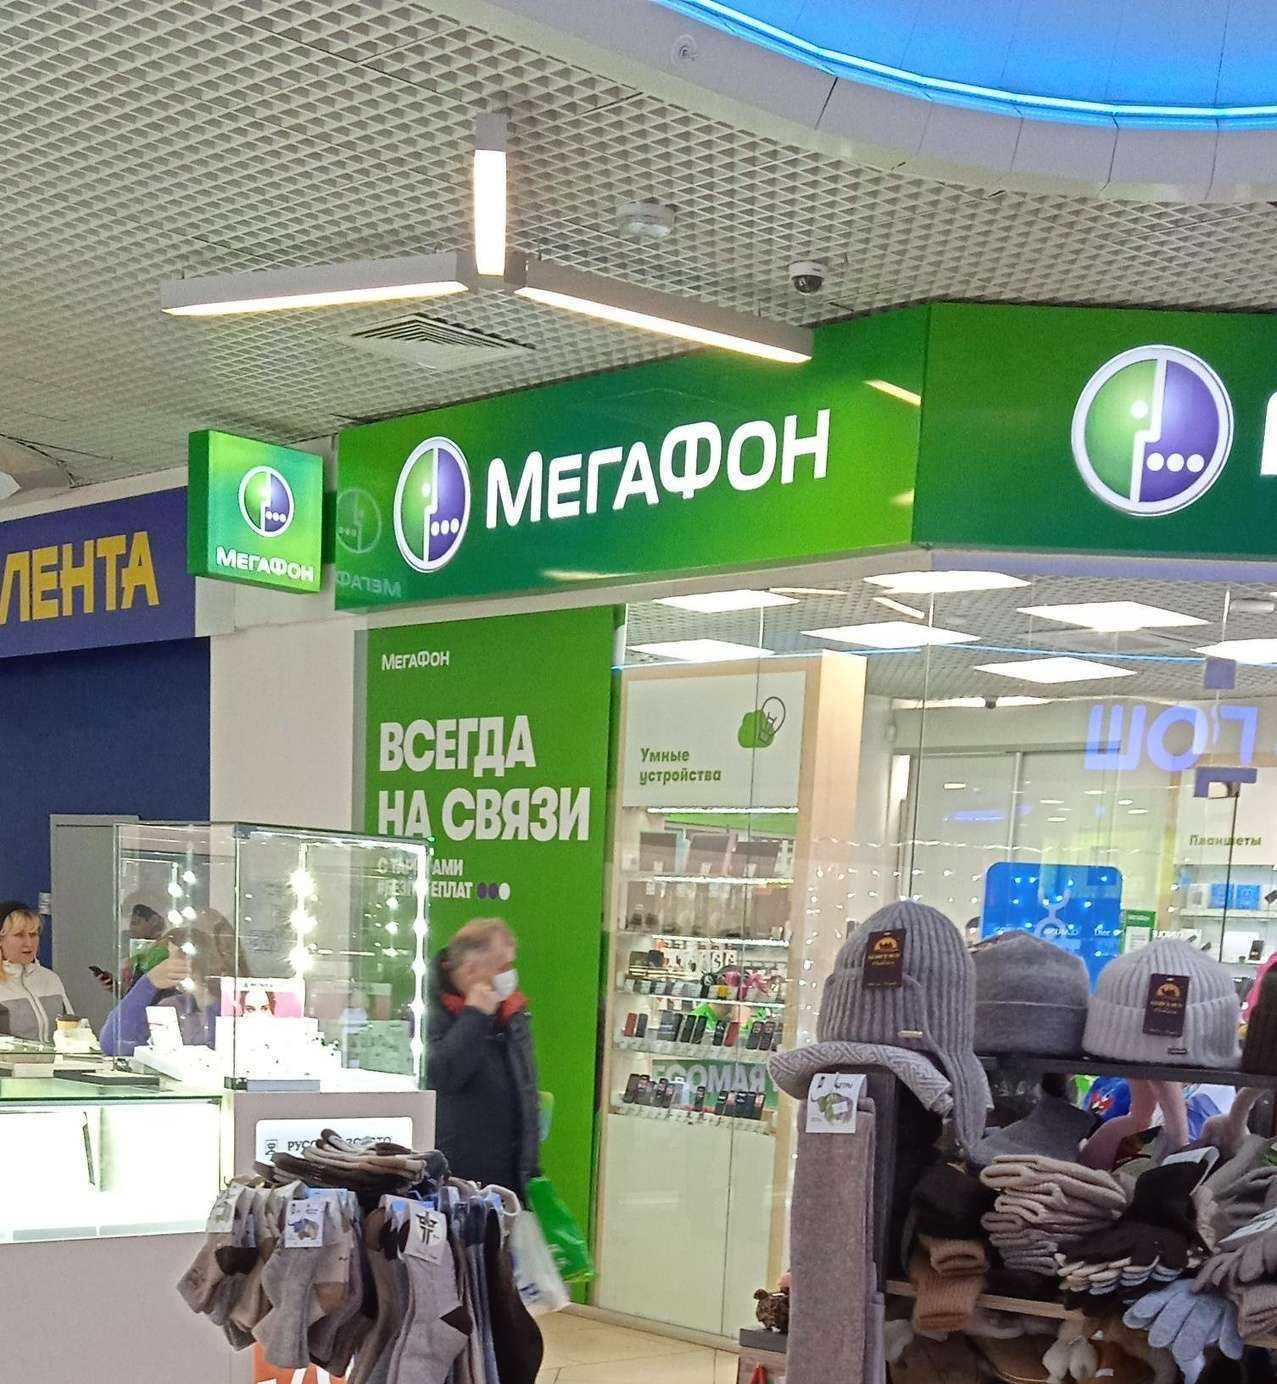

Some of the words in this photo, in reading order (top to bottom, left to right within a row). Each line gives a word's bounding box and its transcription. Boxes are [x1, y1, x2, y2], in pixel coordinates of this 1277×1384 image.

[0, 531, 160, 625] ЛЕНТА
[379, 715, 537, 777] ВСЕГДА
[640, 748, 690, 762] Умные
[639, 767, 721, 785] устройства
[378, 789, 432, 838] НА
[442, 786, 591, 842] СВЯЗИ
